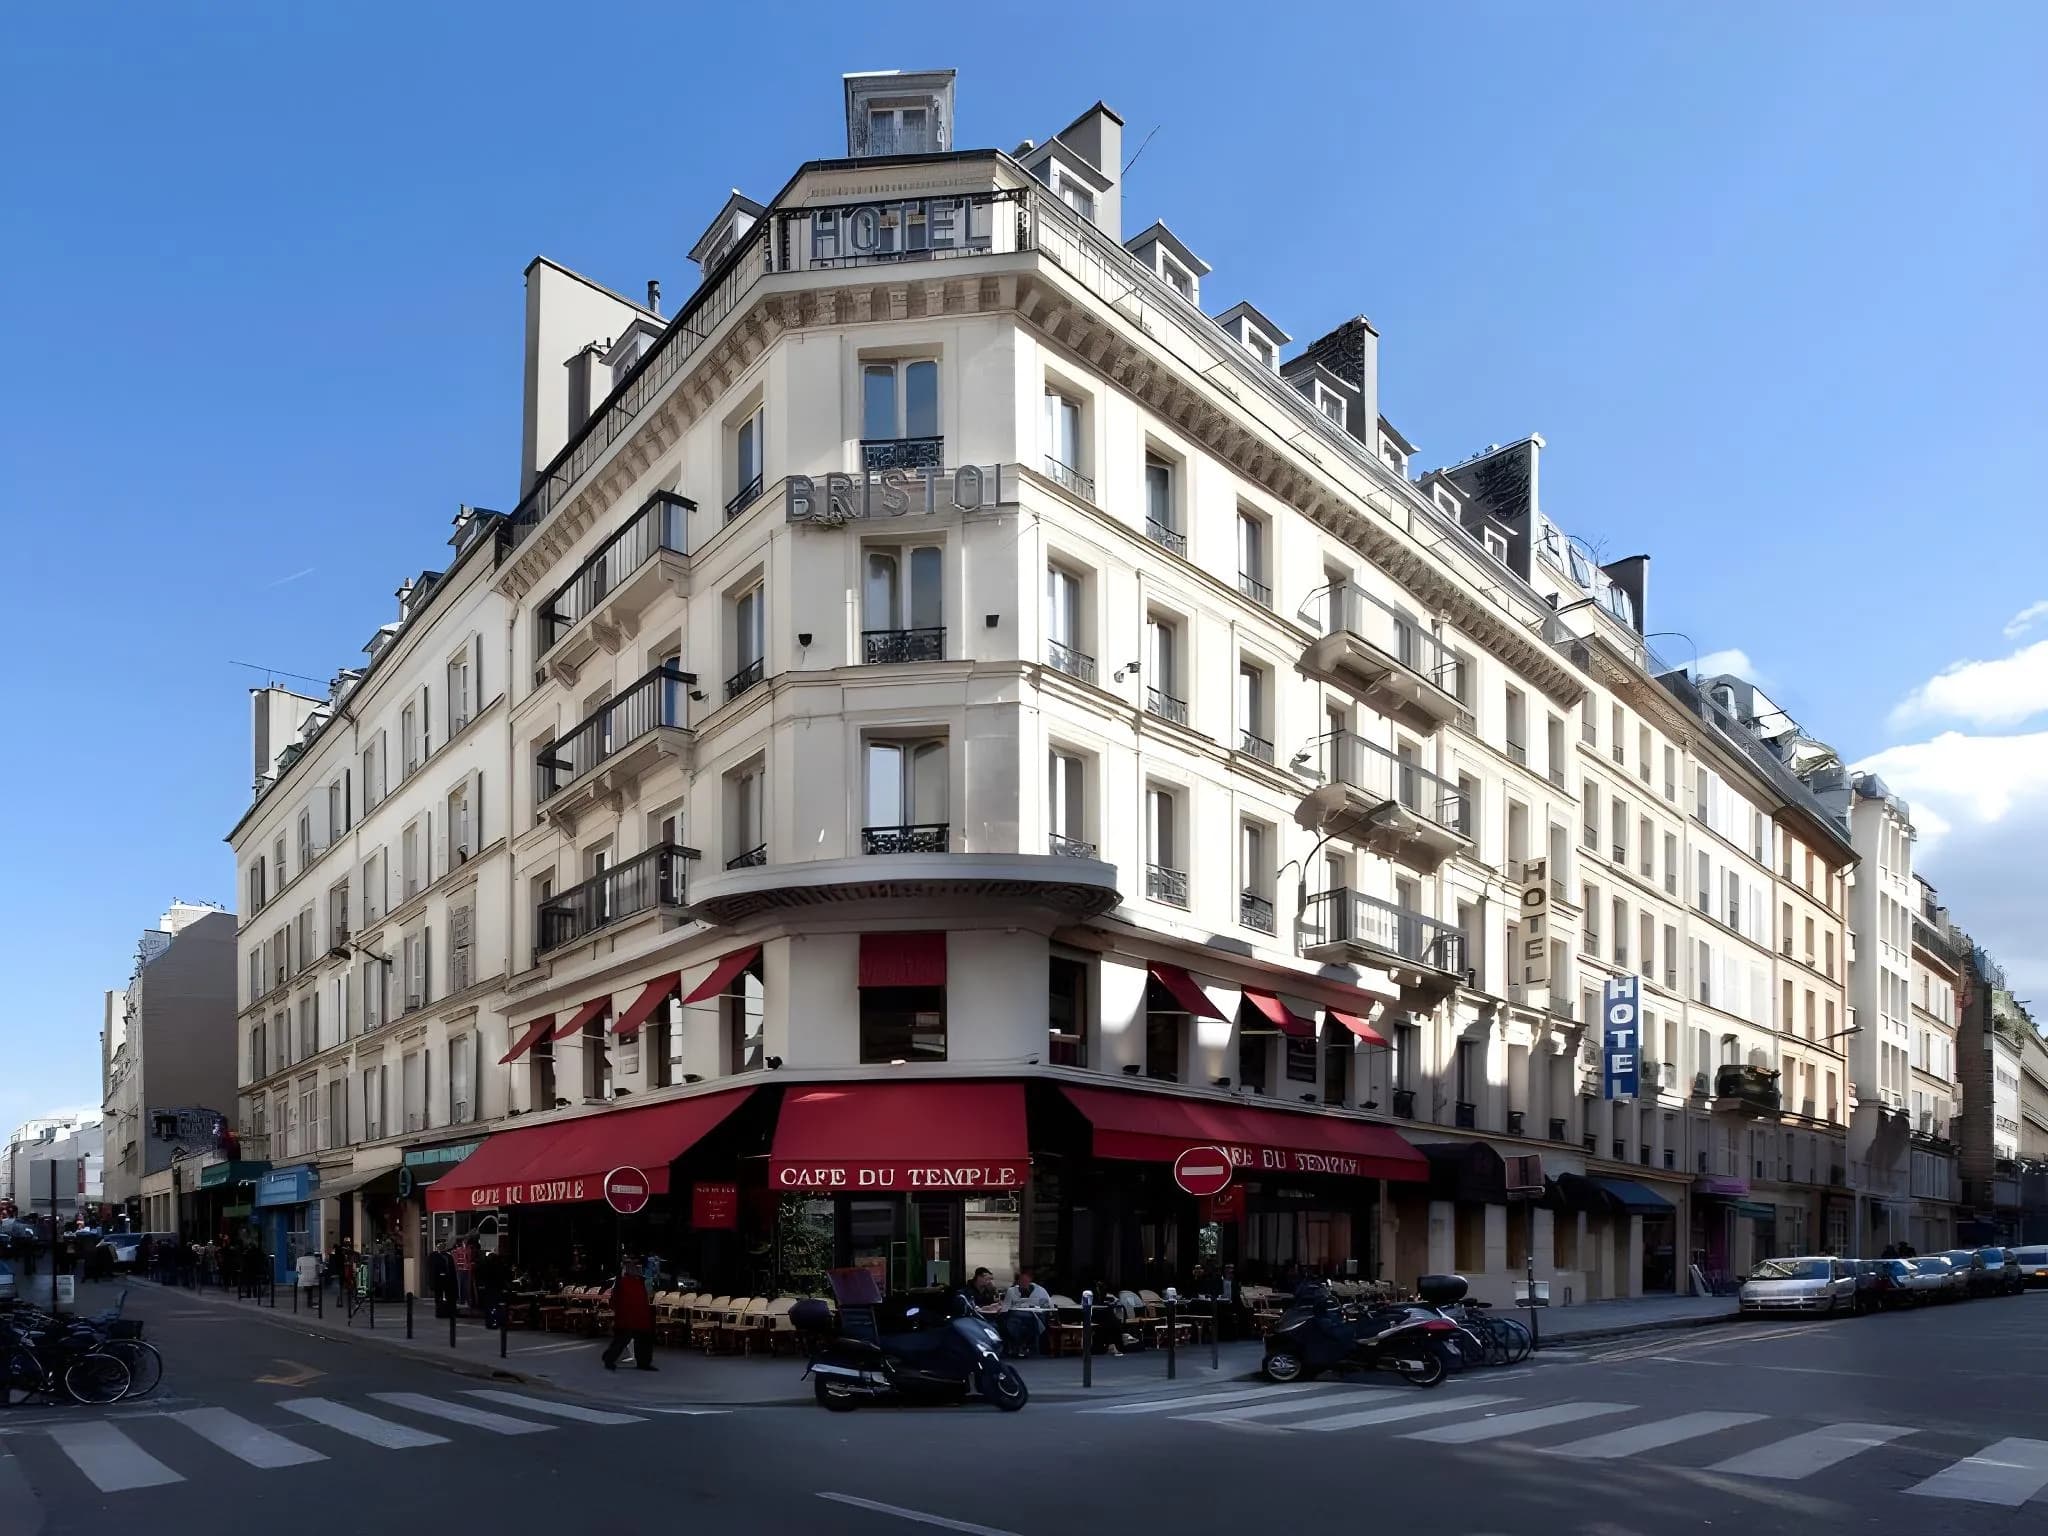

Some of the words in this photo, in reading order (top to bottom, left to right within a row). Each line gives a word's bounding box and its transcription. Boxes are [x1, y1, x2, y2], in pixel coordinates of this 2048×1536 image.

[810, 198, 992, 258] HOTEL
[786, 464, 1018, 523] BRISTOL
[1522, 861, 1546, 983] HOTEL
[1609, 978, 1634, 1099] HOTEL
[780, 1167, 847, 1186] CAFE
[858, 1168, 895, 1186] DU
[907, 1167, 1016, 1186] TEMPLE
[1263, 1149, 1287, 1168] DU
